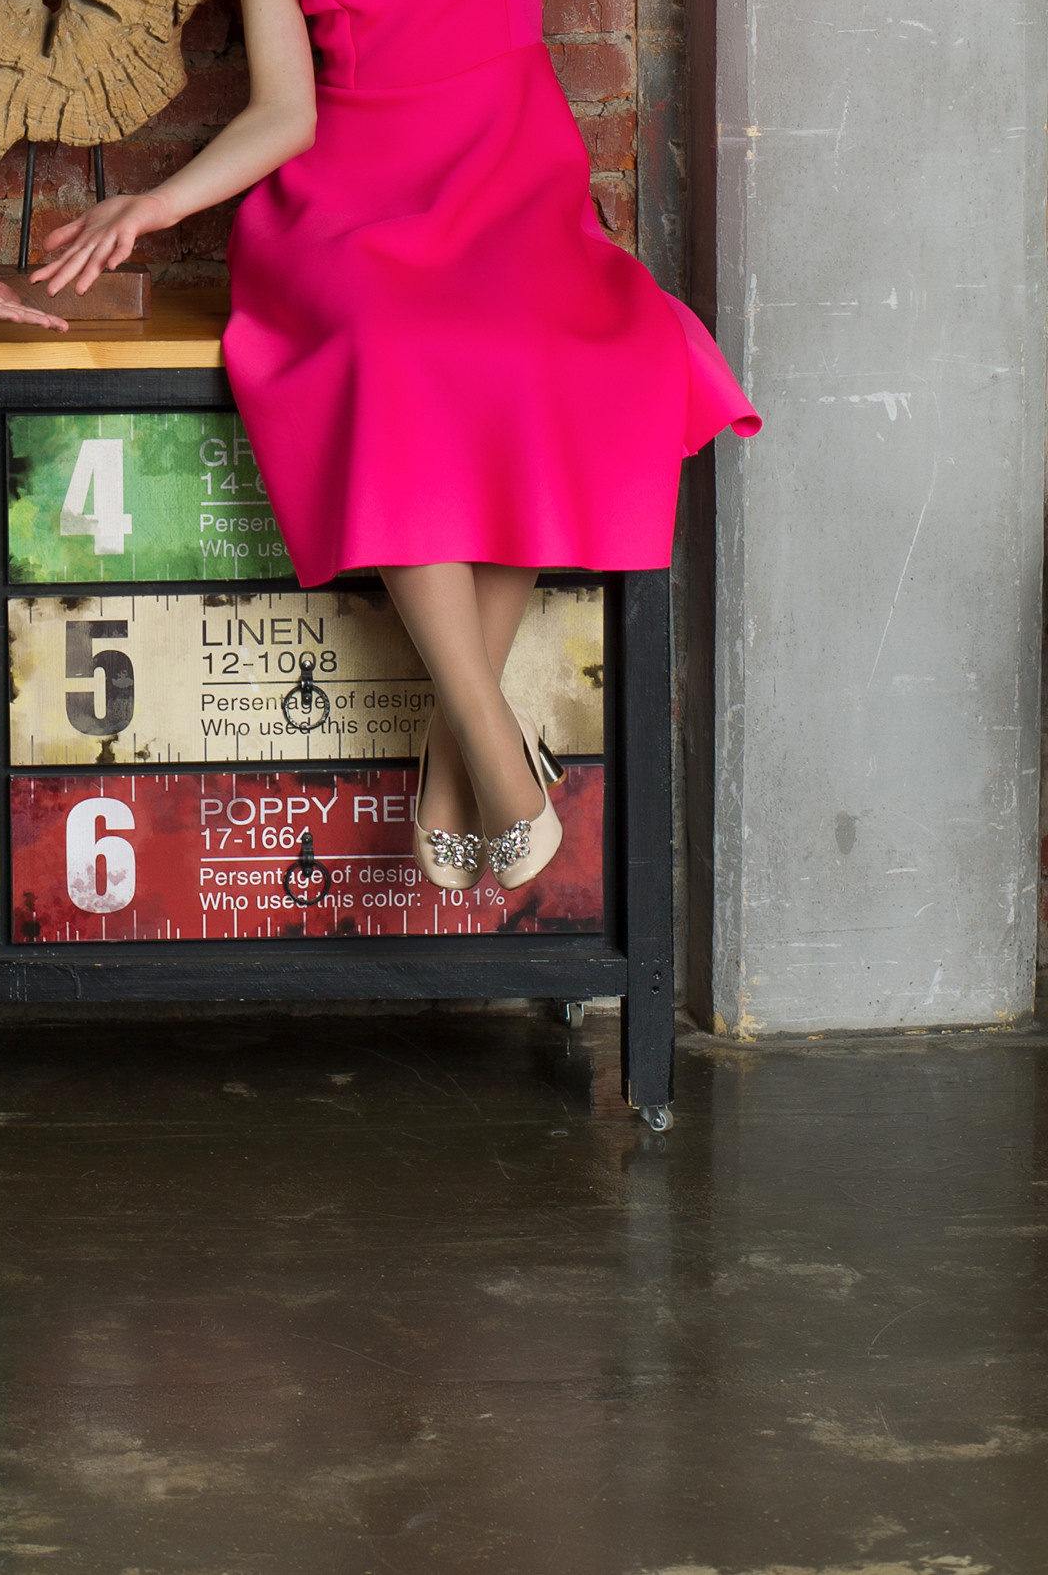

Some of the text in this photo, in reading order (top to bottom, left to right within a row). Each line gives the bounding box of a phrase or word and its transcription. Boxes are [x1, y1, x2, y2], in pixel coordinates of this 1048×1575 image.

[60, 438, 133, 555] 4
[199, 513, 277, 533] Persen
[199, 539, 249, 558] Who
[201, 617, 325, 647] LINEN
[202, 650, 338, 674] 12-1008
[63, 620, 136, 736] 5
[201, 689, 436, 716] Persentage of design
[200, 713, 426, 737] Who used this color:
[200, 796, 338, 826] POPPY
[65, 797, 136, 914] 6
[199, 864, 424, 889] Persentage of desig
[198, 892, 249, 911] Who
[256, 890, 308, 910] used
[362, 888, 422, 908] color:
[438, 887, 506, 908] 10,1%
